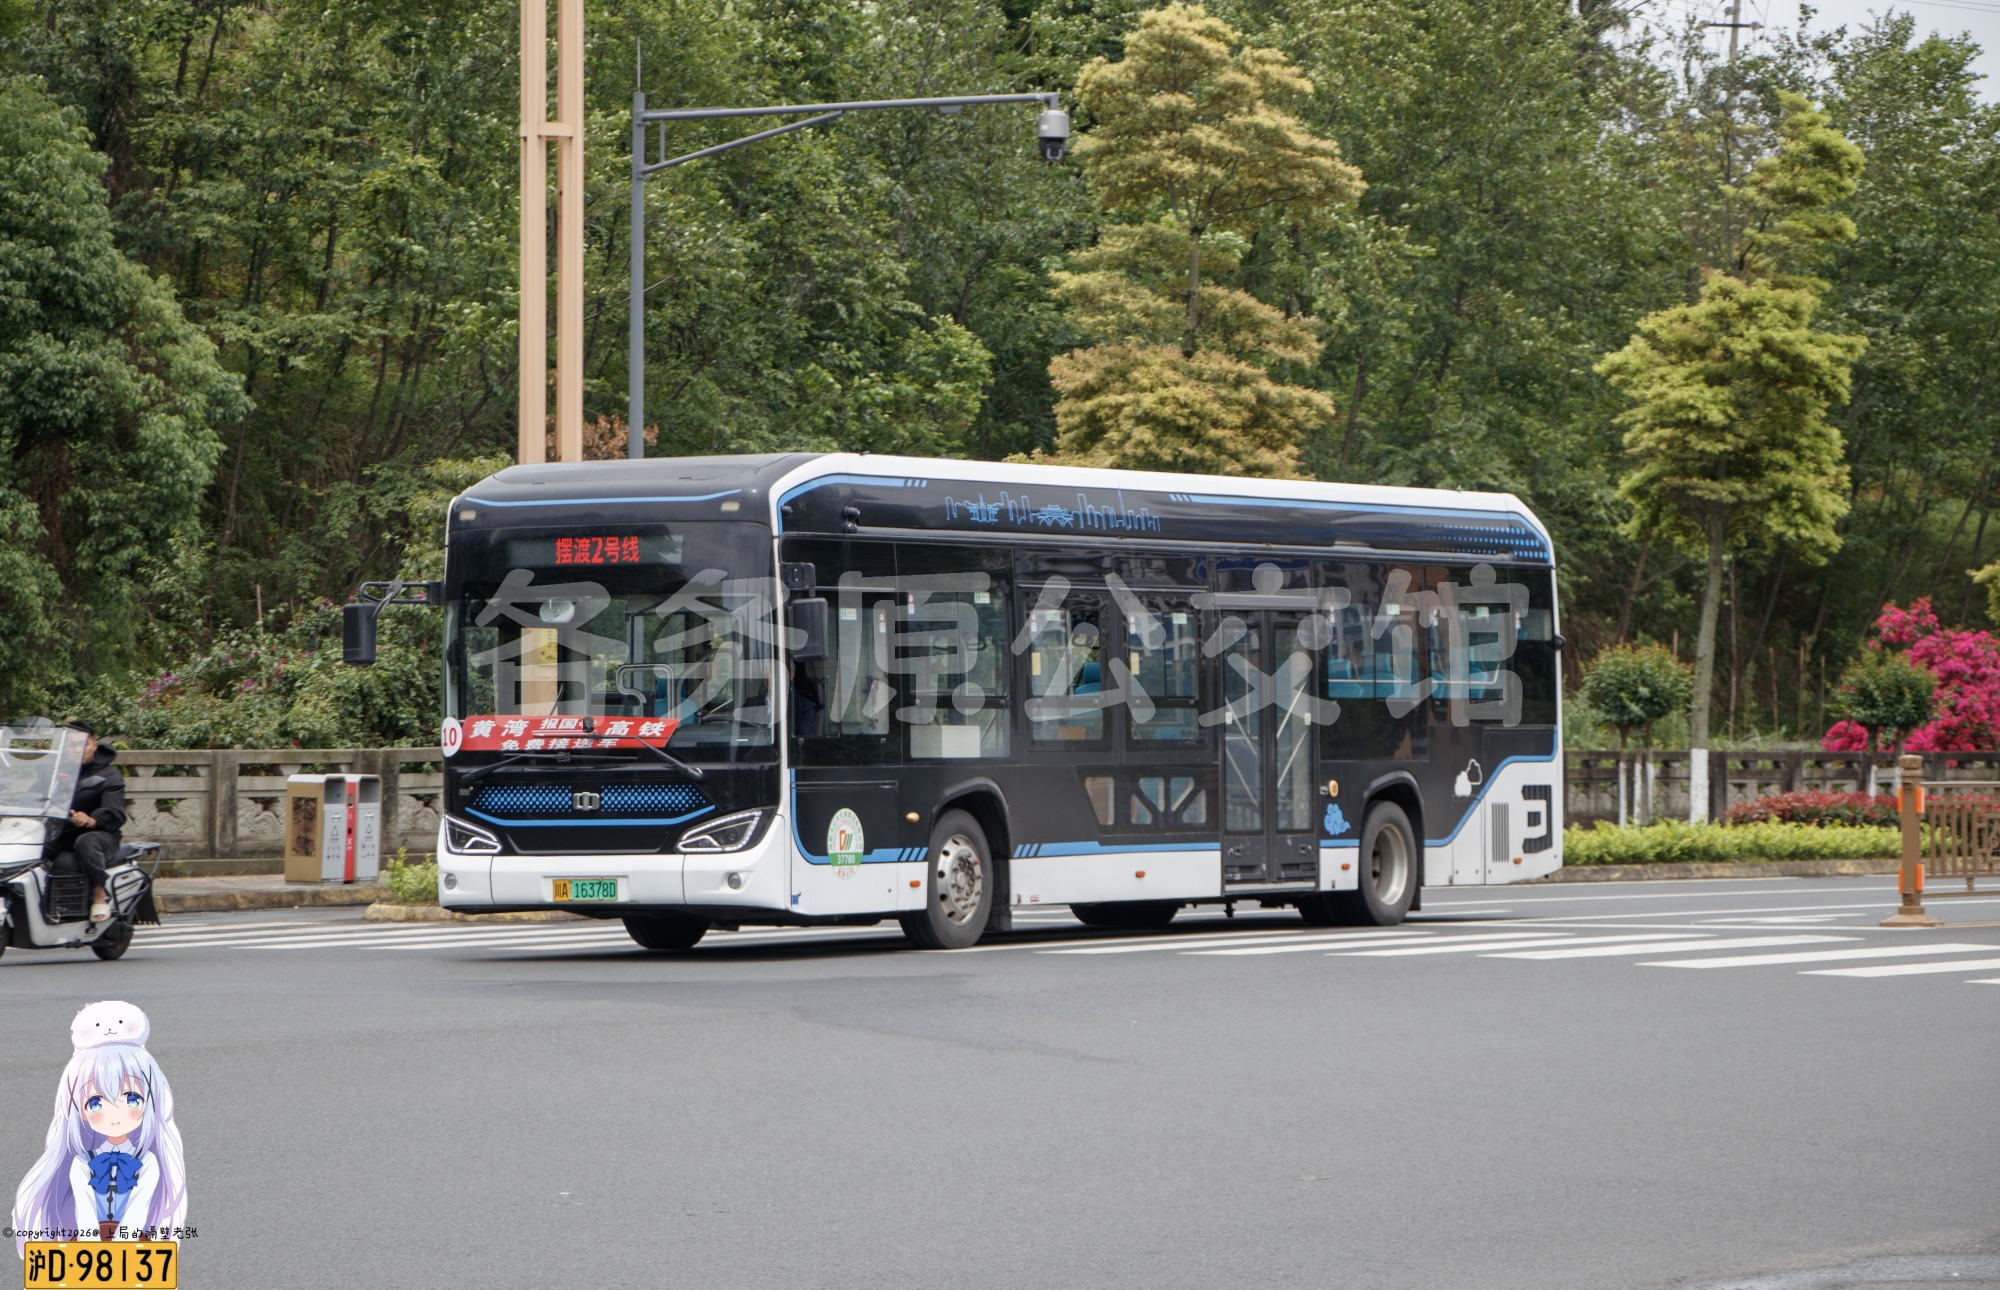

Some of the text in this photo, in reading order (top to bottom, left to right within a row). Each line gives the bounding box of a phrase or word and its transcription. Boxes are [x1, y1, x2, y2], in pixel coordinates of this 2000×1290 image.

[555, 536, 639, 564] 摆渡2号线
[443, 727, 457, 747] 10
[469, 717, 667, 738] 黄湾 报国 高铁
[501, 738, 620, 750] 免费接送车
